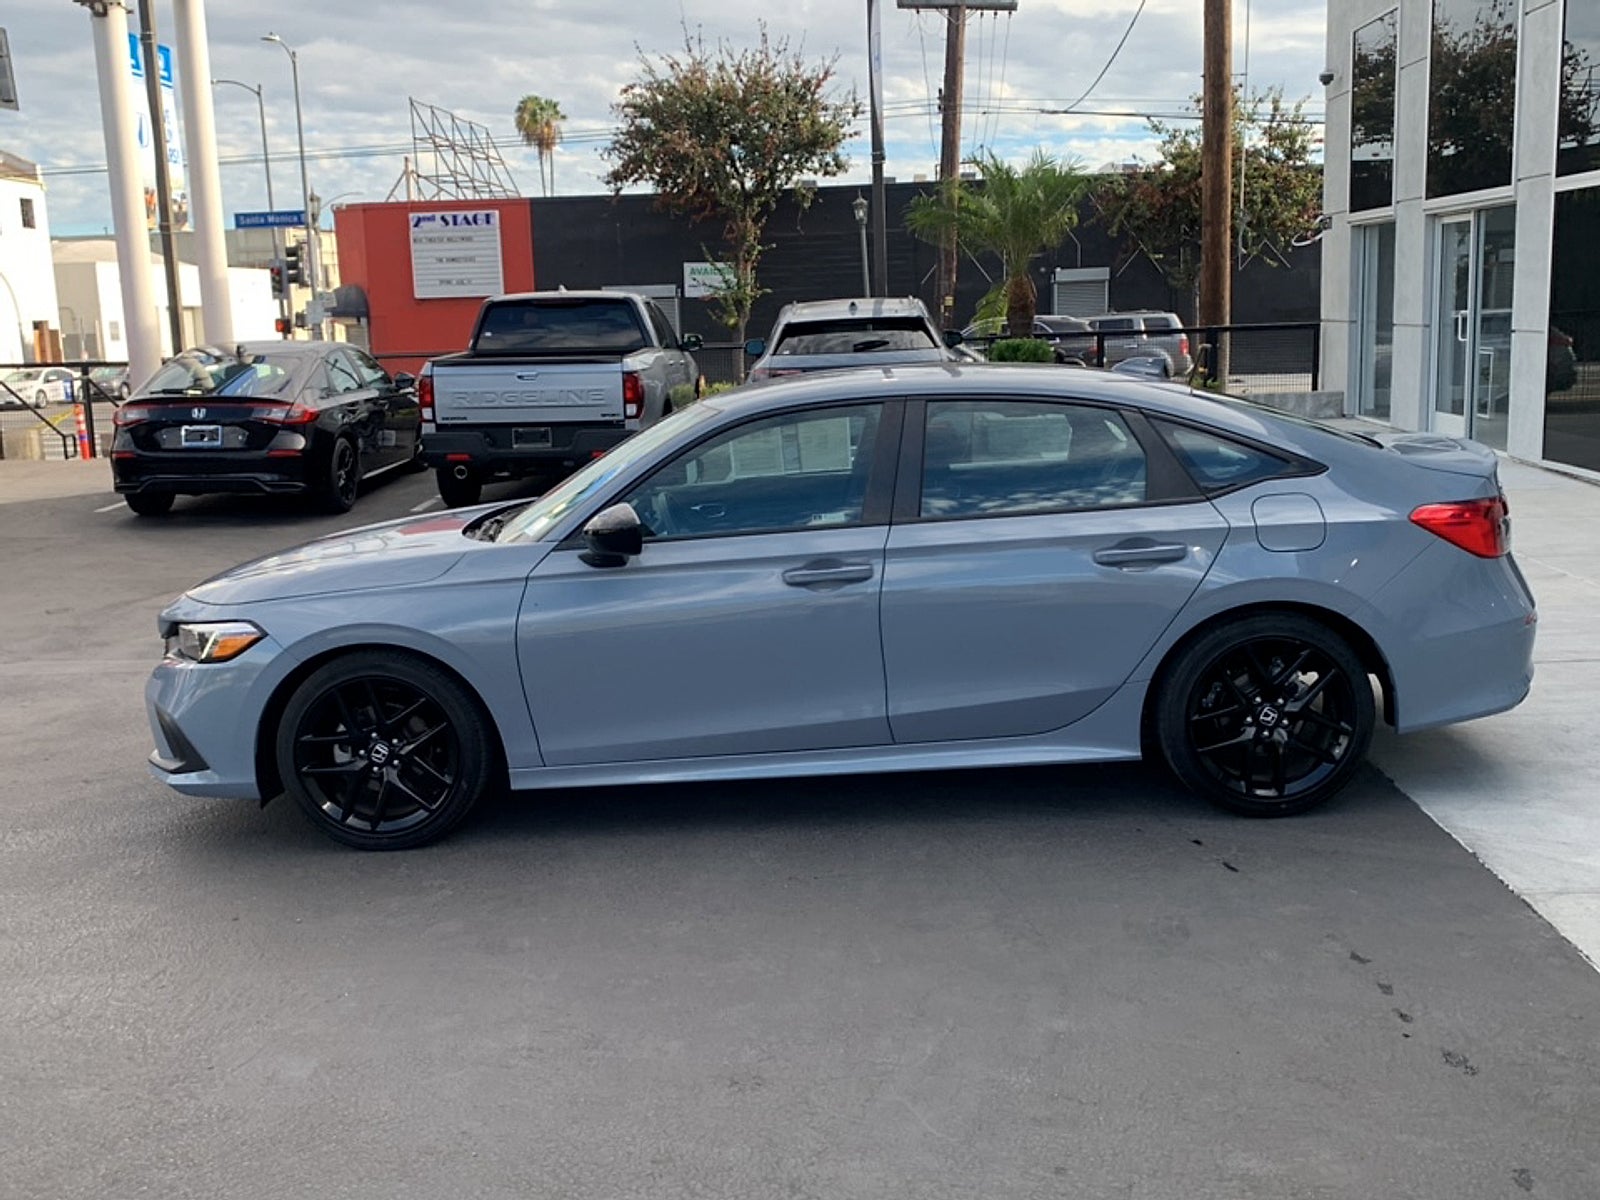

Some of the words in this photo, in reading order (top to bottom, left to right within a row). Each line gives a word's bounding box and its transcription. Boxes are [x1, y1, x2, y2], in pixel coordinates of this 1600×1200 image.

[239, 215, 265, 225] Santa
[267, 213, 298, 223] Monica
[440, 213, 497, 227] STAGE
[451, 388, 606, 406] RIDGELINE
